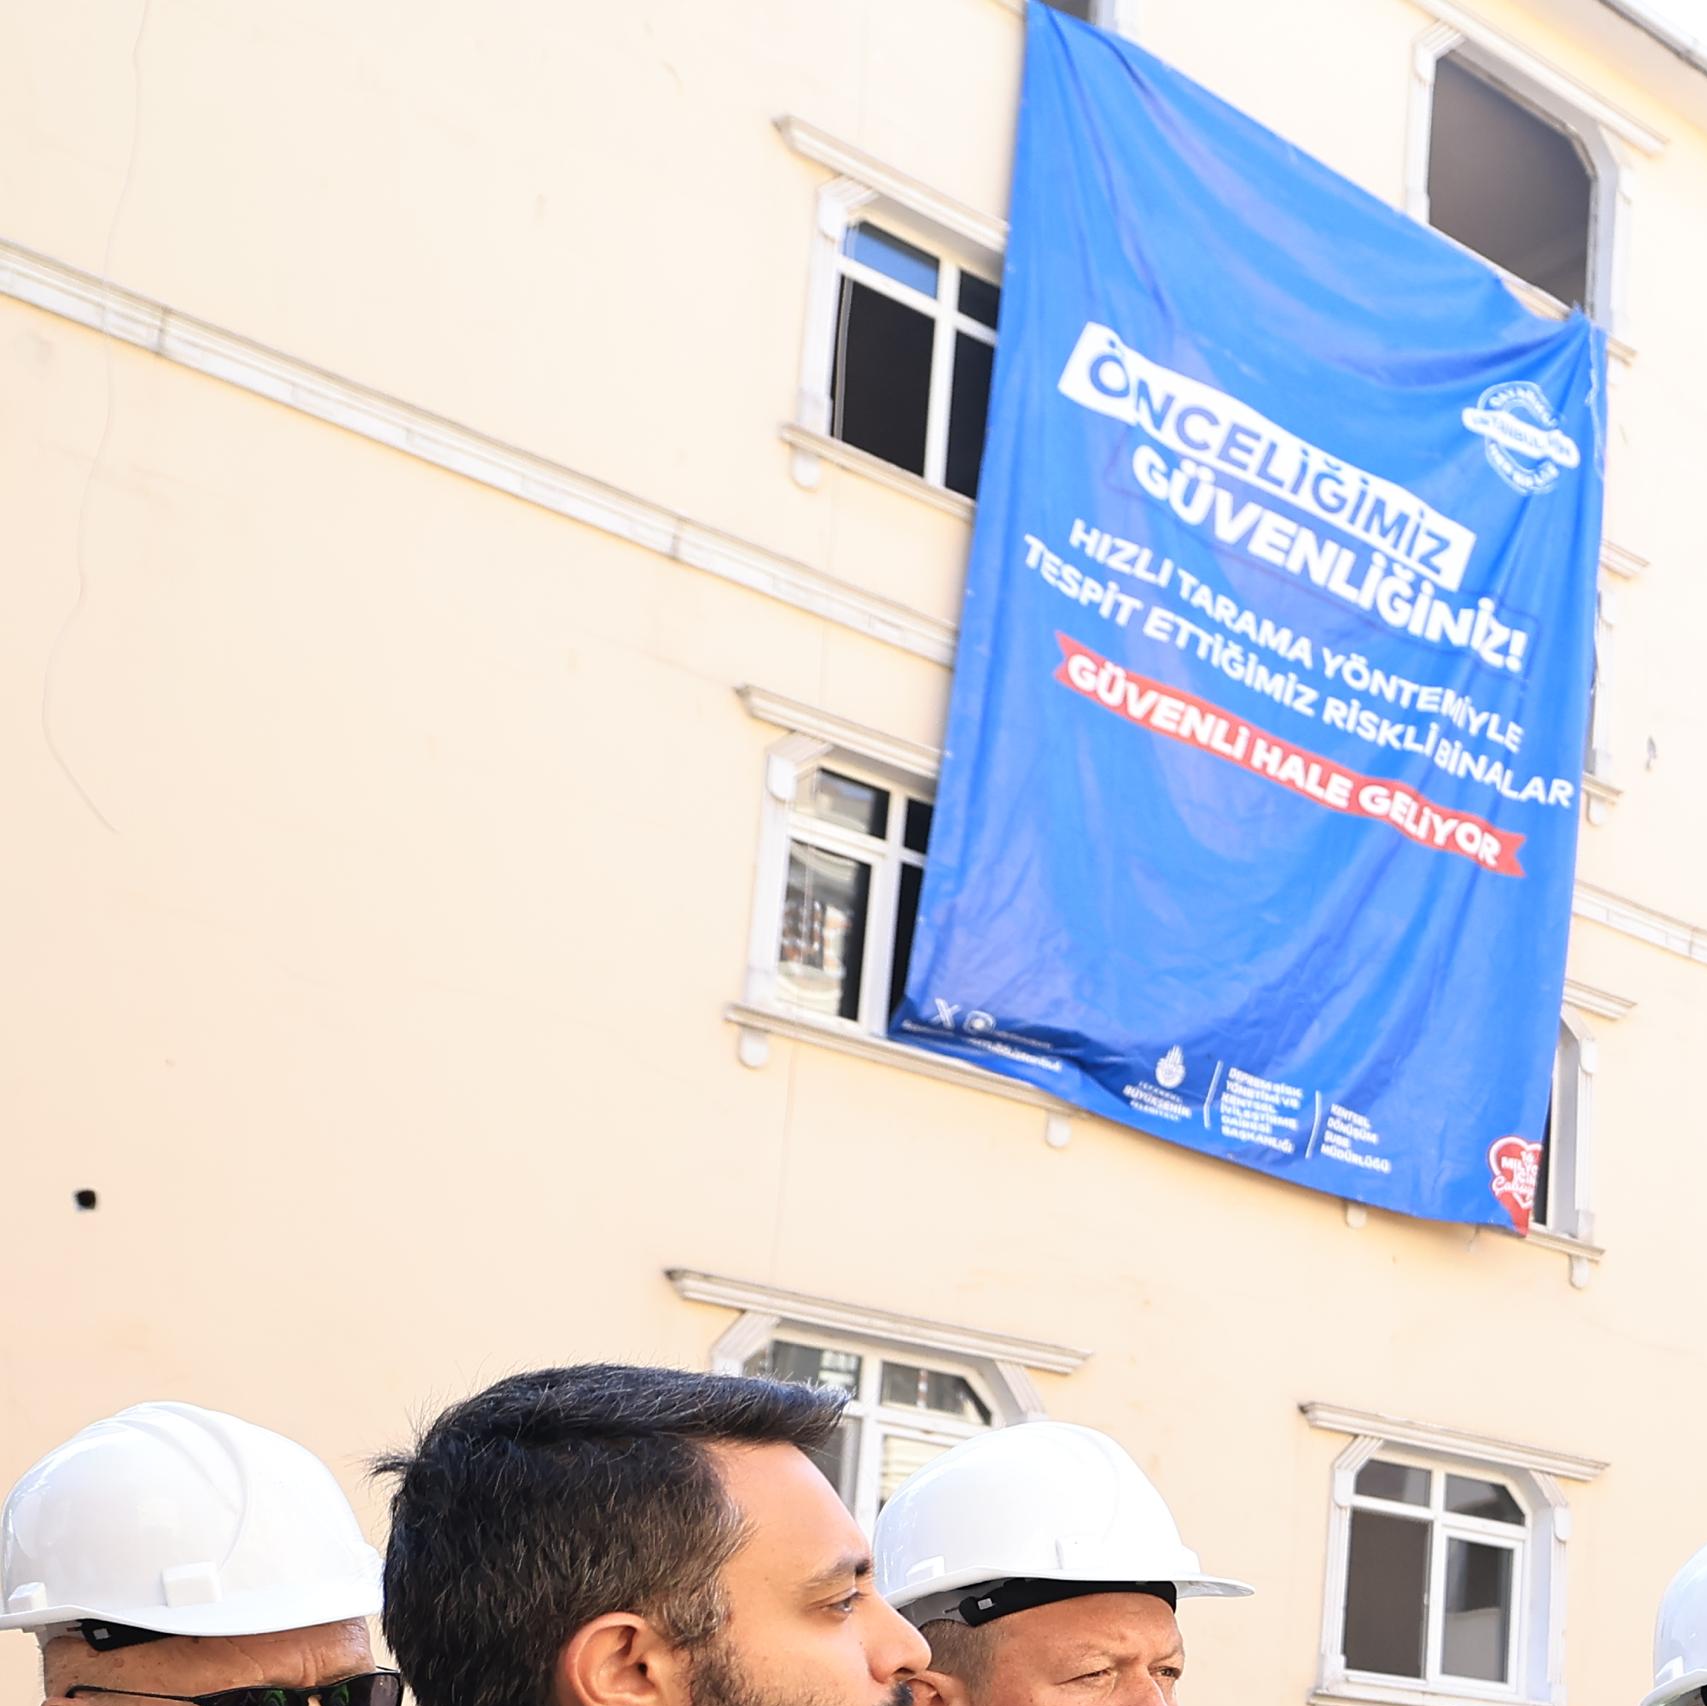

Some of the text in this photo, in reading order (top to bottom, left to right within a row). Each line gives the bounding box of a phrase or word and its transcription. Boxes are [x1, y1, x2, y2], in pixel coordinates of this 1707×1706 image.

[1088, 337, 1454, 578] ÖNCELİĞİMİZ
[1132, 444, 1529, 673] GÜVENLİĞİNİZ!
[1024, 533, 1575, 808] TESPİT ETTİĞİMİZ RİSKLİ BİNALAR
[1069, 518, 1524, 753] HIZLI TARAMA YÖNTEMİYLE
[1067, 653, 1502, 866] GÜVENLİ HALE GELİYOR
